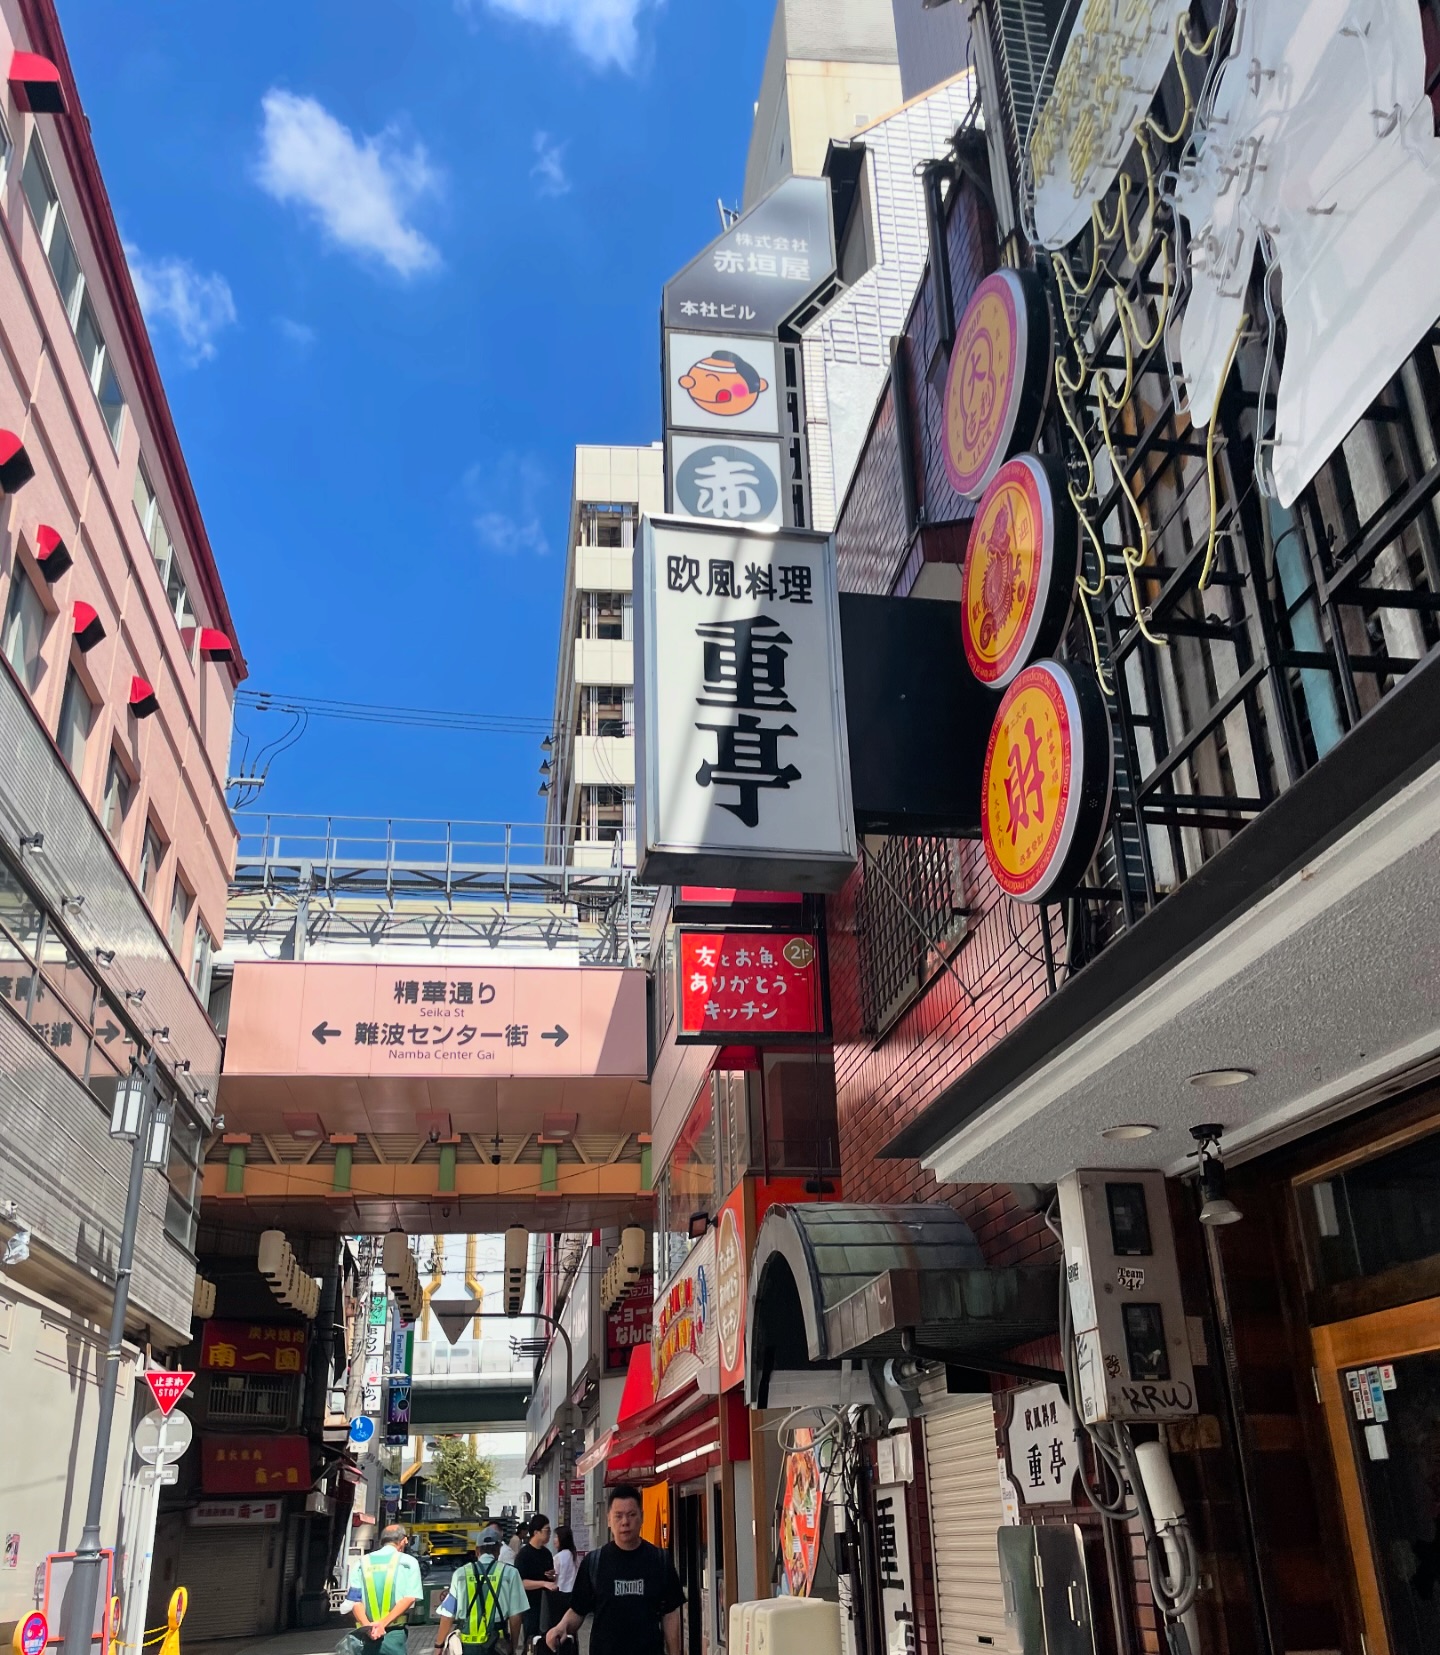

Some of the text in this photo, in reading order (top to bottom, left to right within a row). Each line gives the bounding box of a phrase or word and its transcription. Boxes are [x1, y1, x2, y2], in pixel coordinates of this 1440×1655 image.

[735, 232, 809, 253] 株式会社
[713, 250, 811, 281] 赤垣屋
[680, 300, 756, 321] 本社ビル
[667, 554, 813, 604] 欧風料理
[695, 615, 802, 828] 重亭
[695, 946, 778, 968] 友とお魚
[790, 945, 810, 960] 2F
[393, 980, 497, 1005] 精華通り
[690, 972, 788, 995] ありがとう
[419, 1007, 465, 1018] Seika St
[704, 1000, 778, 1020] キッチン
[354, 1022, 529, 1047] 難波センター街
[388, 1049, 495, 1060] Namba Center Gai
[154, 1376, 184, 1387] 止まれ
[158, 1388, 180, 1397] STOP
